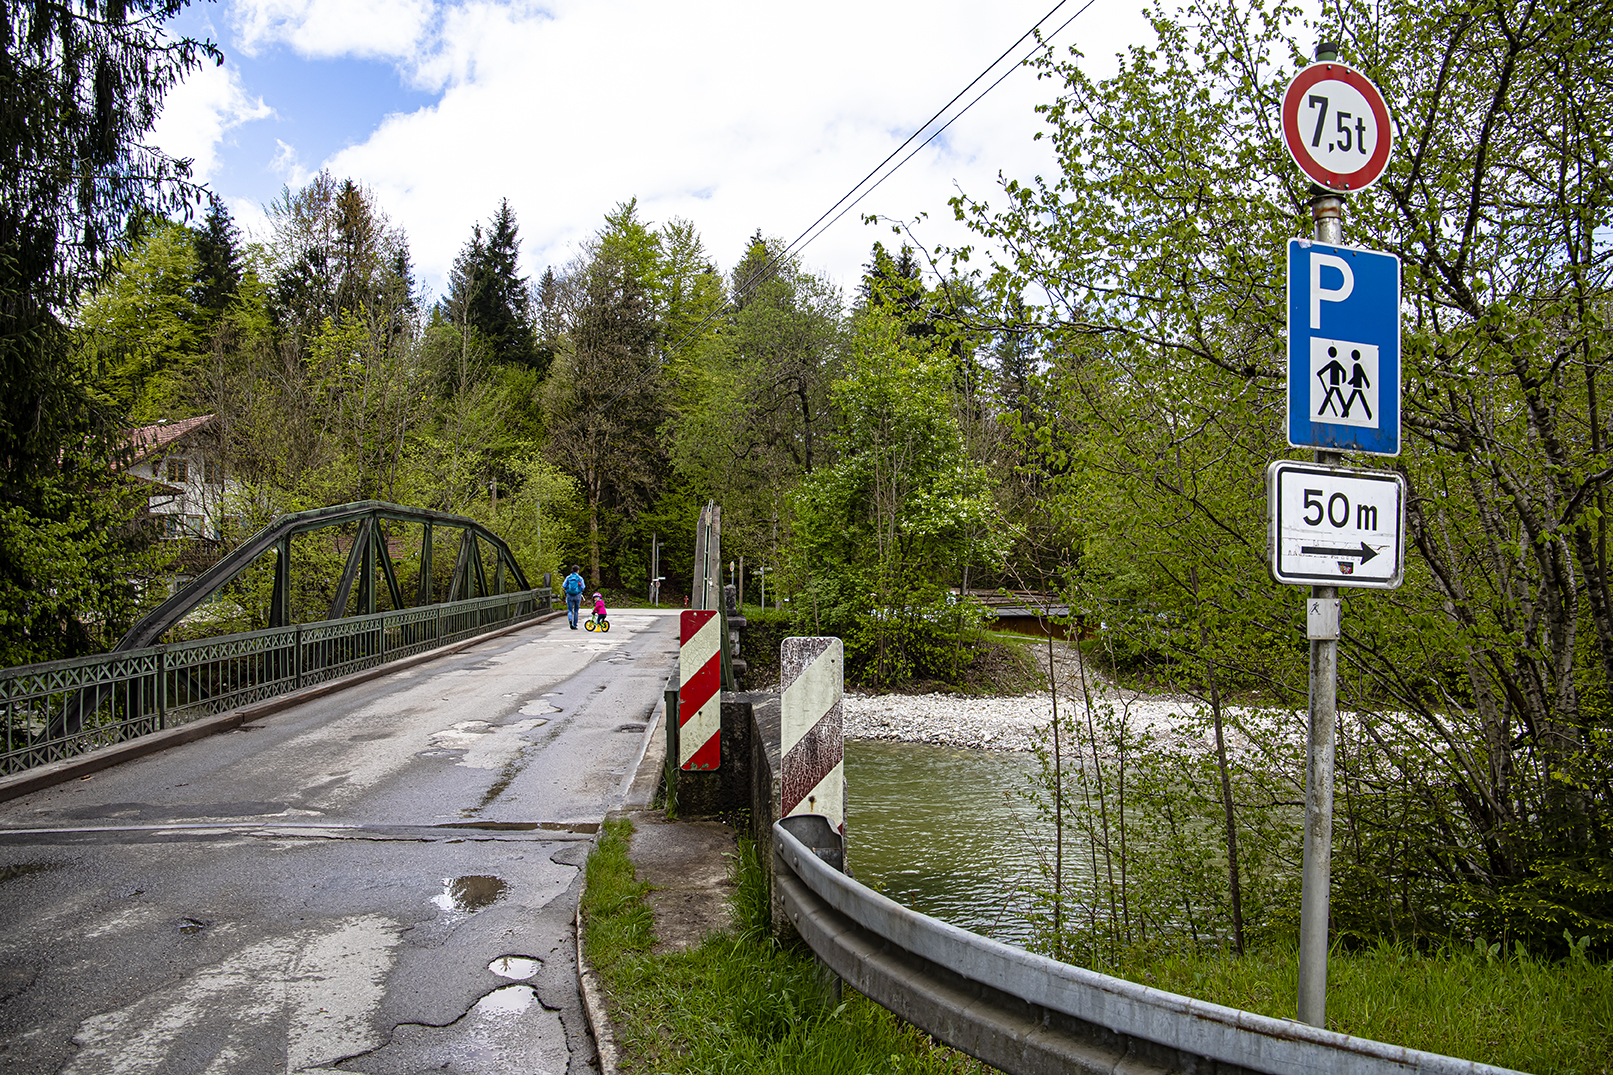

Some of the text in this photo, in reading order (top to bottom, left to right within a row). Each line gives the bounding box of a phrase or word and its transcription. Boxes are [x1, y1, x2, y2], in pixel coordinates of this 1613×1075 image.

[1309, 251, 1355, 330] P
[1303, 488, 1378, 531] 50 m
